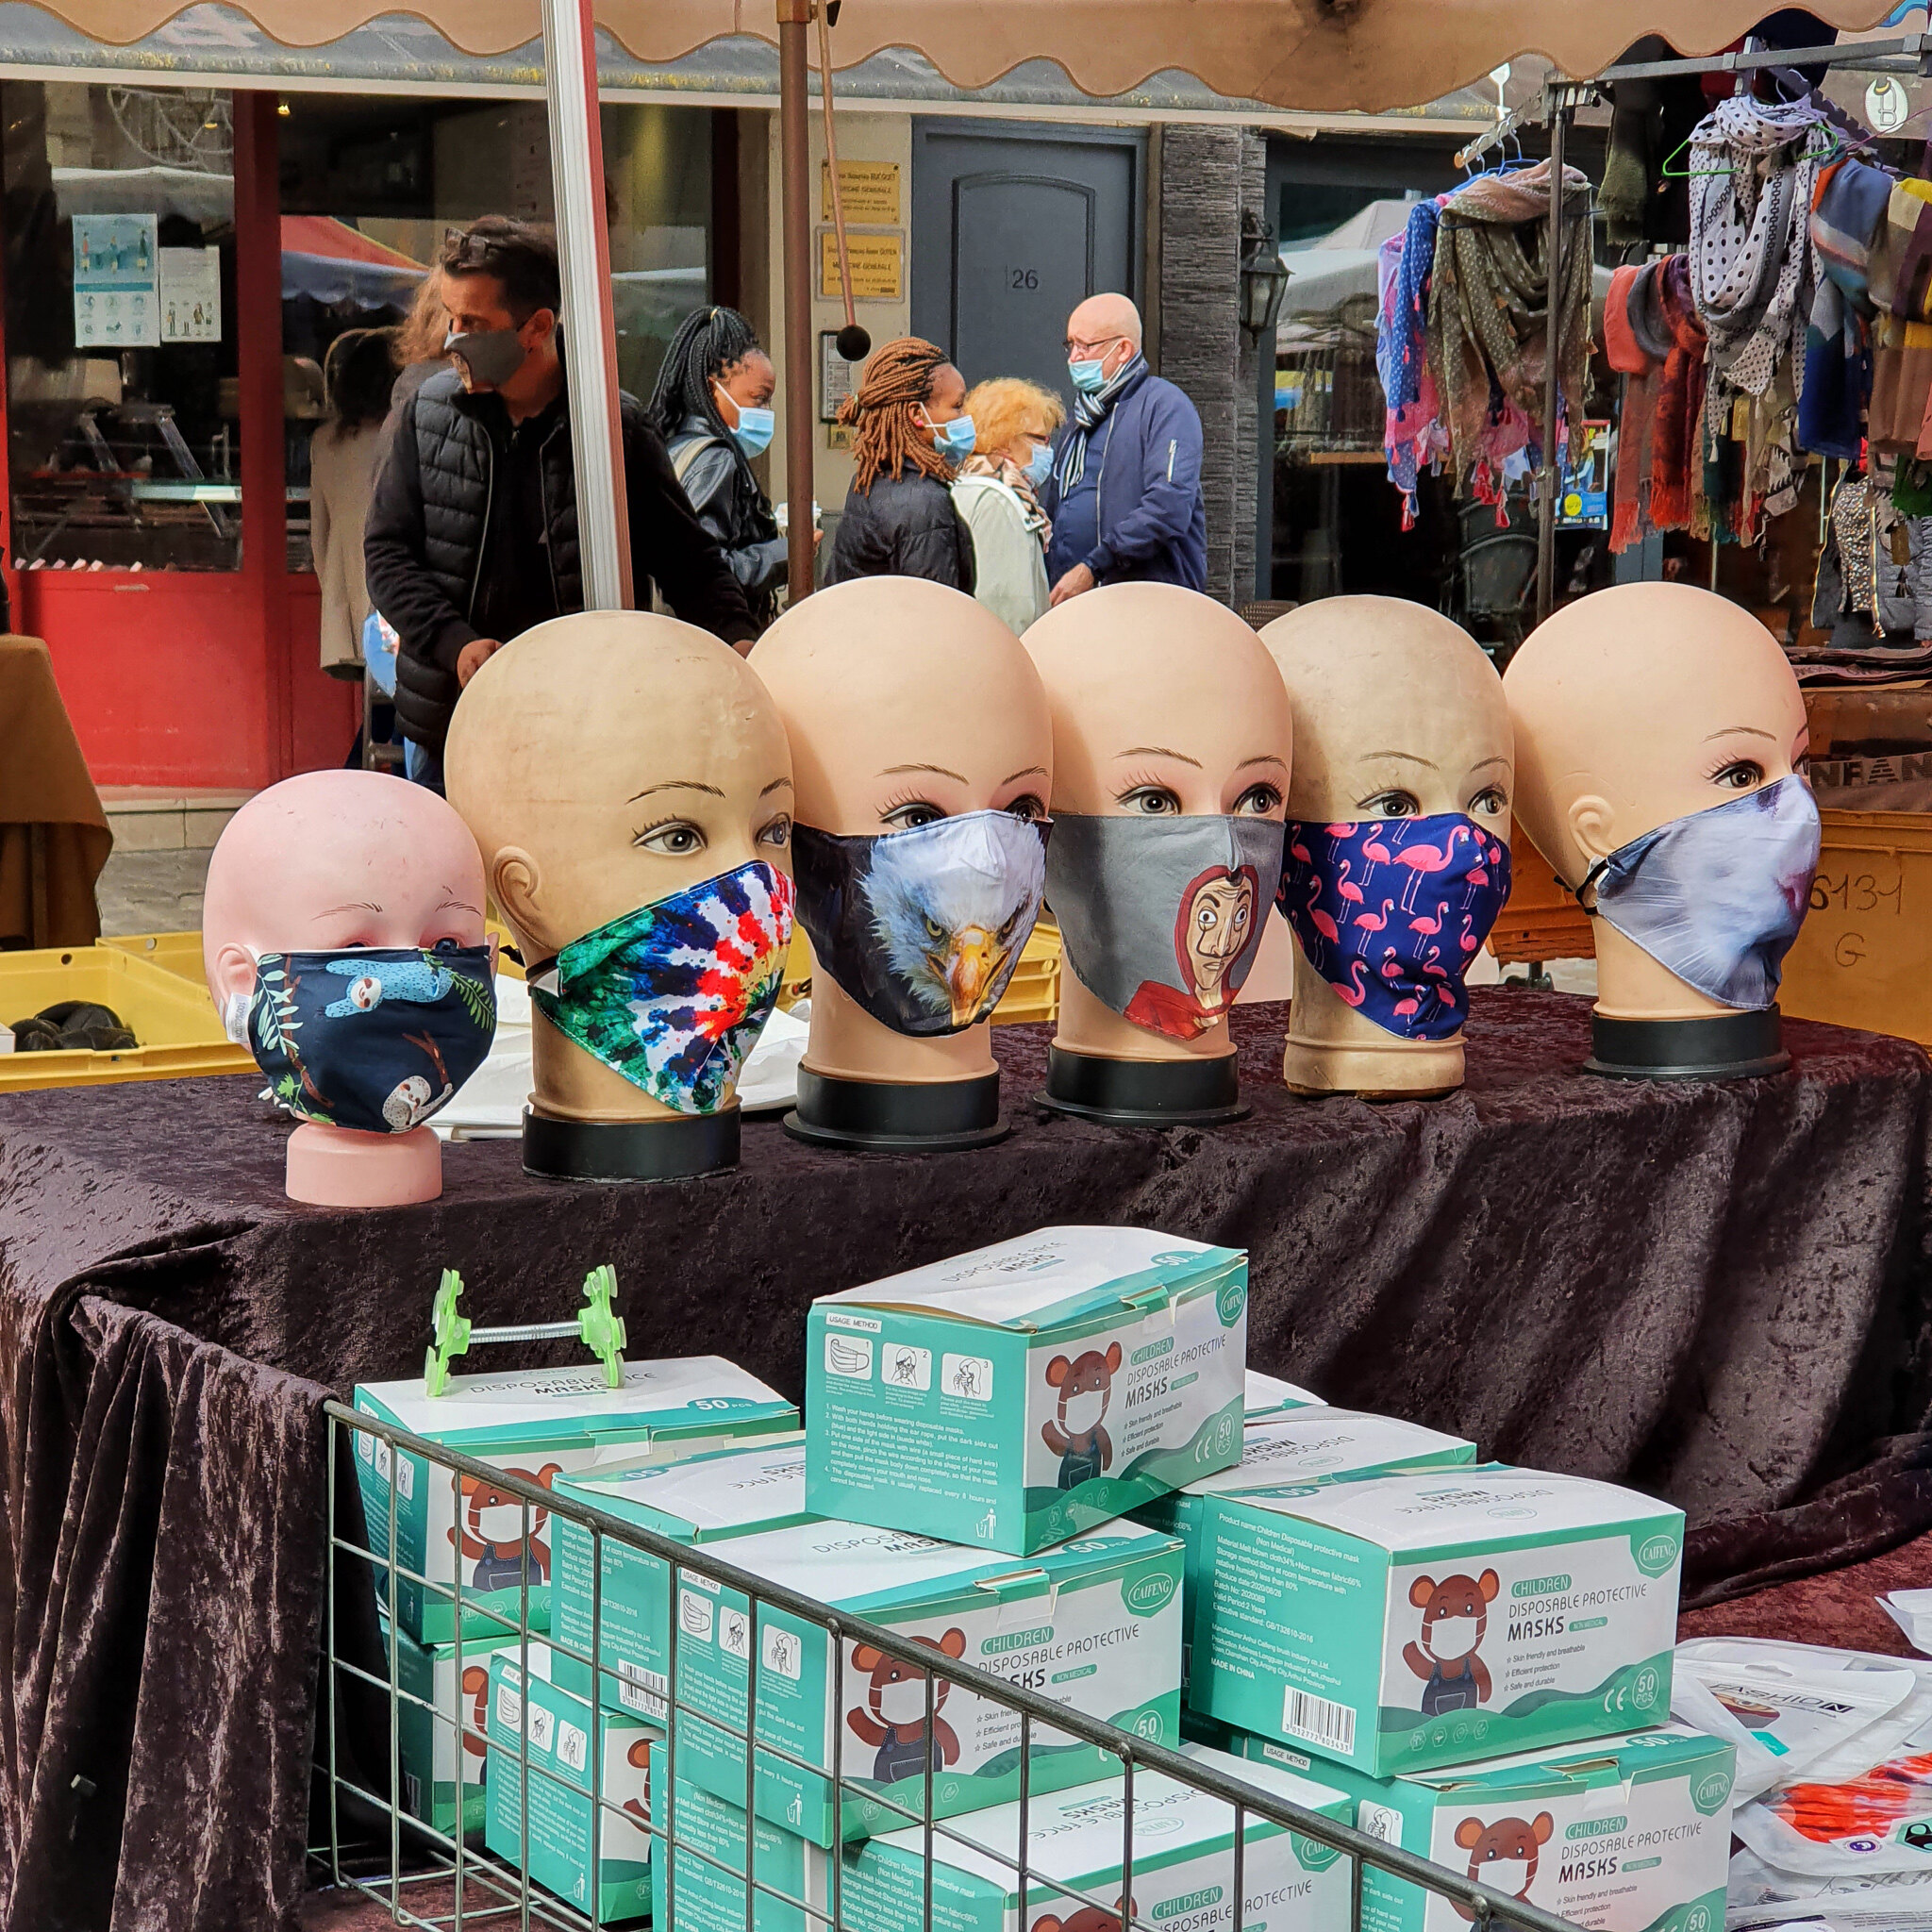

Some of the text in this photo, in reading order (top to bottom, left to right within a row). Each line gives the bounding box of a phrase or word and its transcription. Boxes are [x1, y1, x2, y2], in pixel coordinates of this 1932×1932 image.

[1012, 269, 1038, 290] 26
[1835, 932, 1866, 967] G
[1155, 1255, 1190, 1266] 50
[829, 1315, 878, 1330] USAGE METHOD
[1127, 1354, 1179, 1386] DISPOSABLE
[1181, 1334, 1226, 1365] PROTECTIVE
[1133, 1338, 1171, 1365] CHILDREN
[470, 1376, 604, 1393] DISPOSABLE
[534, 1383, 611, 1395] MASKS
[1124, 1376, 1169, 1409] MASKS
[693, 1398, 729, 1411] 50
[1219, 1419, 1231, 1440] 50
[1219, 1512, 1241, 1527] Product
[1281, 1532, 1313, 1550] Disposable
[1342, 1553, 1360, 1563] mask
[1070, 1541, 1107, 1554] 50
[700, 1577, 719, 1591] METHOD
[1133, 1579, 1170, 1602] CAIFENG
[1513, 1575, 1570, 1597] CHILDREN
[1508, 1583, 1648, 1618] DISPOSABLE PROTECTIVE
[1507, 1616, 1565, 1642] MASKS
[978, 1624, 1140, 1674] DISPOSABLE PROTECTIVE
[984, 1627, 1050, 1654] CHILDREN
[1512, 1644, 1586, 1663] Skin friendly and breathable
[1056, 1668, 1093, 1682] NON MEDICAL
[1210, 1657, 1256, 1679] MADE IN CHINA
[1511, 1662, 1560, 1677] Efficient protection
[1509, 1676, 1556, 1691] Safe and durable
[1638, 1674, 1656, 1692] 50
[1635, 1690, 1655, 1704] PCS
[1709, 1683, 1857, 1713] FASHION
[984, 1711, 999, 1722] Skin
[983, 1724, 1009, 1737] Efficient
[1138, 1719, 1158, 1737] 50
[982, 1737, 1012, 1751] Safe and
[1633, 1736, 1669, 1748] 50
[1266, 1747, 1307, 1767] USAGE METHOD
[1567, 1817, 1624, 1839] CHILDREN
[1561, 1822, 1703, 1860] DISPOSABLE PROTECTIVE
[1558, 1857, 1618, 1884] MASKS
[1155, 1889, 1220, 1919] CHILDREN
[1244, 1879, 1312, 1914] ROTECTIVE
[1563, 1895, 1576, 1905] Skin
[1597, 1890, 1608, 1898] and
[1584, 1903, 1611, 1915] protection
[1585, 1917, 1606, 1928] durable
[1689, 1912, 1706, 1929] 50
